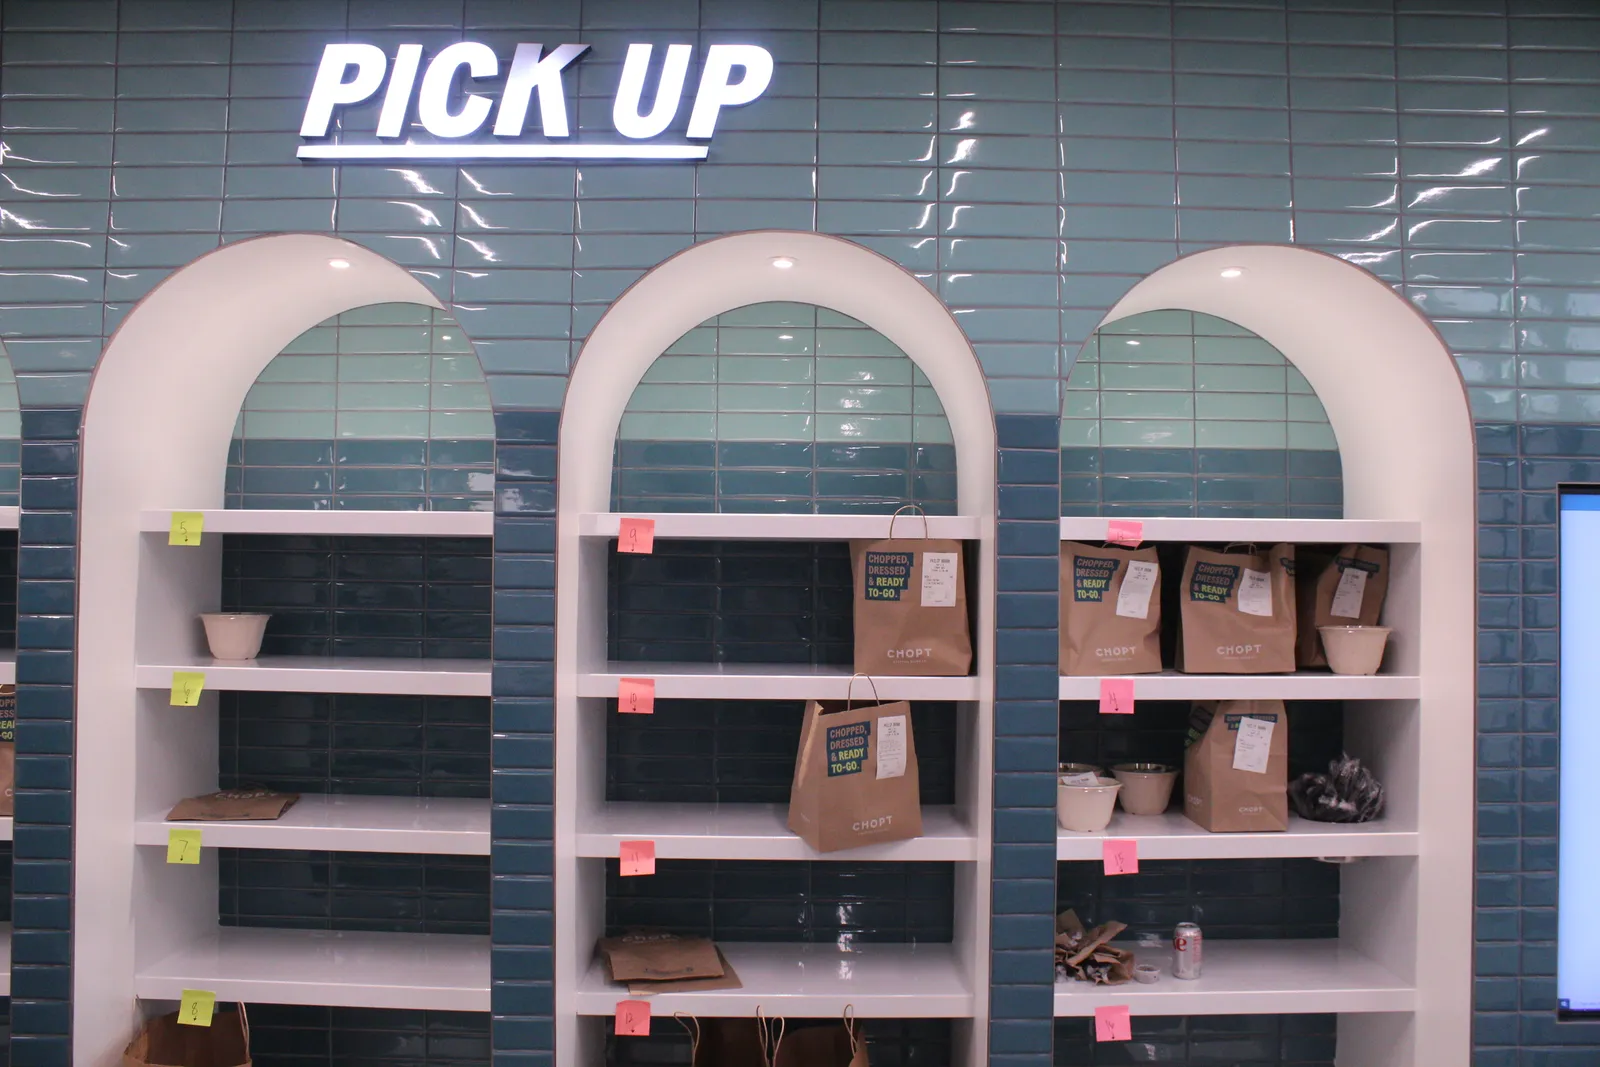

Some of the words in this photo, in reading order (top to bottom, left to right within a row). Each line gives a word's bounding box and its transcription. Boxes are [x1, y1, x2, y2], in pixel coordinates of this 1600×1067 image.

[299, 41, 592, 139] PICK
[612, 42, 774, 140] UP
[629, 528, 637, 543] 9
[868, 554, 910, 565] CHOPPED,
[1076, 558, 1115, 569] CHOPPED,
[868, 566, 906, 575] DRESSED
[1075, 568, 1109, 577] DRESSED
[868, 577, 875, 586] &
[876, 577, 905, 586] READY
[1076, 580, 1082, 588] &
[1083, 579, 1107, 588] READY
[1195, 575, 1230, 586] DRESSED
[868, 588, 898, 598] TO-GO.
[1076, 590, 1101, 599] TO-GO.
[1193, 583, 1200, 591] &
[1201, 584, 1228, 595] READY
[887, 648, 932, 658] CHOPT
[1095, 646, 1137, 657] CHOPT
[1216, 644, 1262, 655] CHOPT
[629, 692, 638, 705] 10
[829, 725, 867, 739] CHOPPED,
[830, 736, 865, 750] DRESSED
[831, 752, 837, 762] &
[838, 748, 864, 761] READY
[831, 761, 860, 773] TO-GO.
[852, 815, 893, 831] CHOPT
